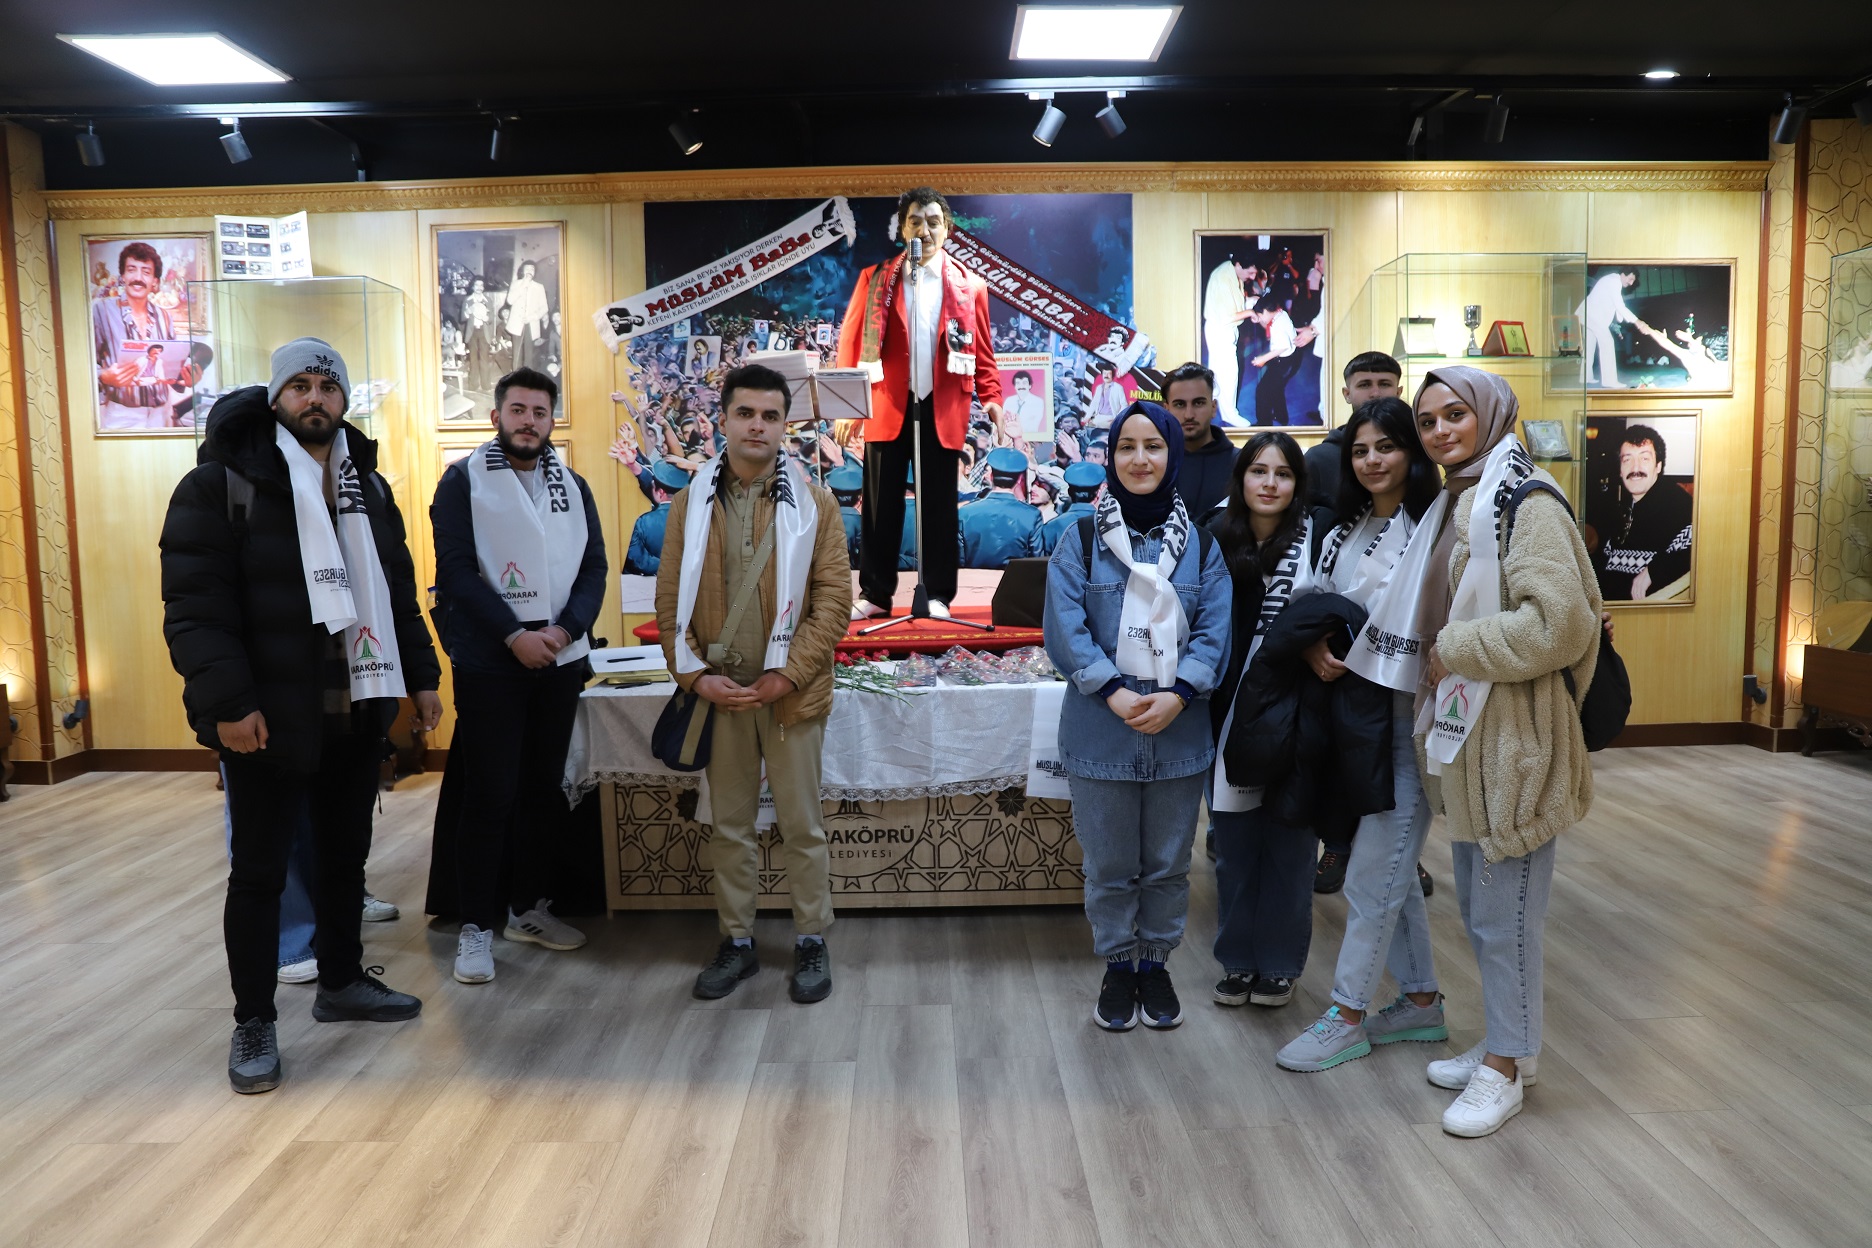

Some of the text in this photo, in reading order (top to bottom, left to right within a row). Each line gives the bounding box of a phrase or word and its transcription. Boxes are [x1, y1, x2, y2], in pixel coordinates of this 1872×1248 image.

[954, 231, 979, 249] Mutlu
[663, 285, 675, 295] BİZ
[676, 278, 696, 289] SANA
[697, 266, 719, 279] BEYAZ
[756, 233, 783, 252] DERKEN
[943, 238, 1022, 292] MÜSLÜM
[647, 313, 671, 326] KEFENİ
[731, 279, 750, 290] BABA
[801, 242, 816, 254] UYU
[1004, 292, 1031, 311] Nerden
[305, 365, 340, 381] adidas
